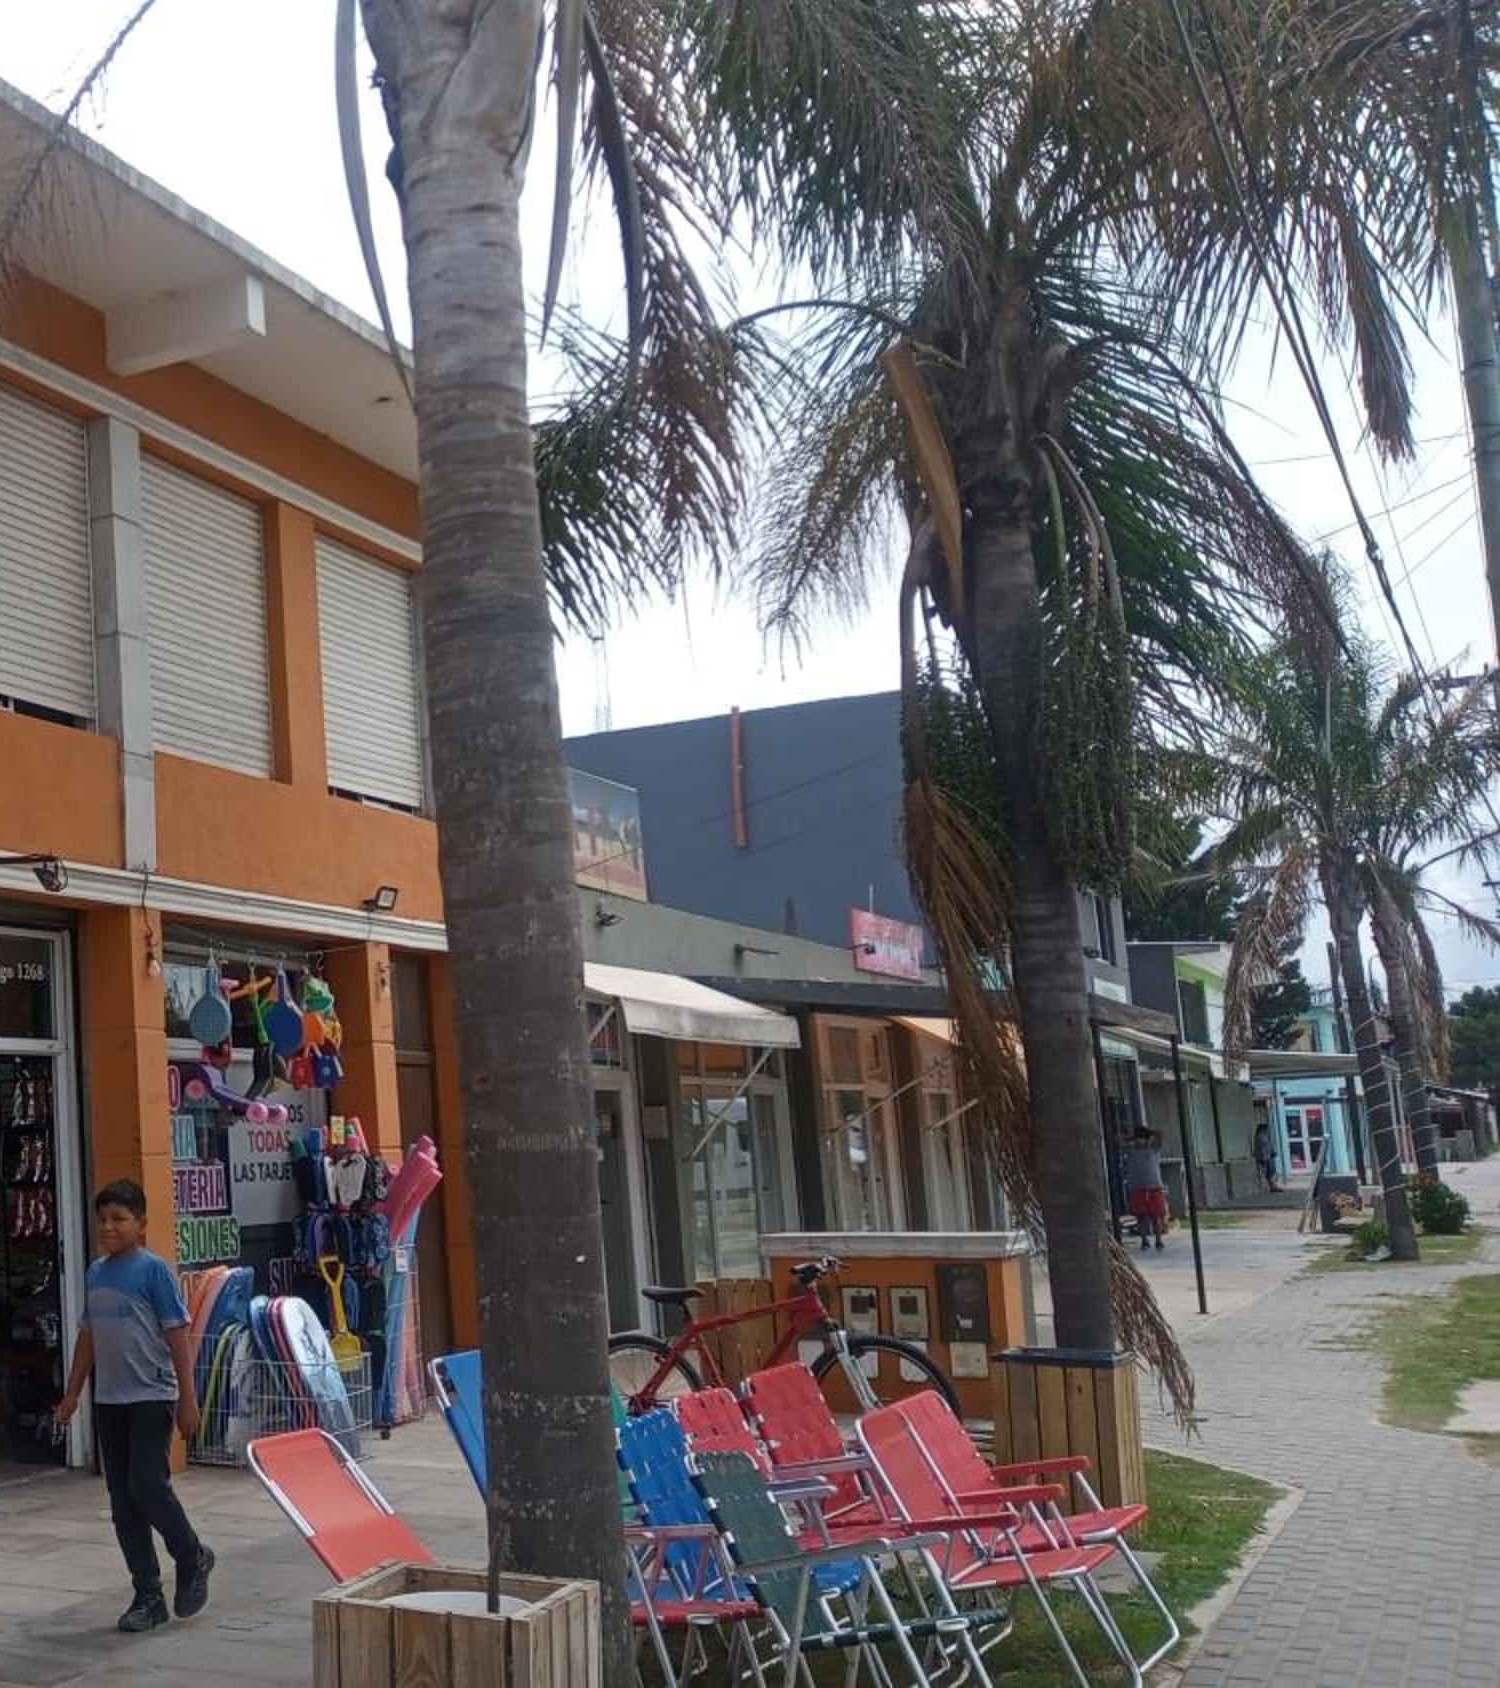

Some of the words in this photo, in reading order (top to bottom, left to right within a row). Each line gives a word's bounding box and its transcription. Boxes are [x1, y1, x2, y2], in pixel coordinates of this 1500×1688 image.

[17, 962, 45, 981] 1268
[247, 1130, 293, 1153] TODAS
[233, 1163, 257, 1183] LAS
[258, 1161, 295, 1182] TARJE
